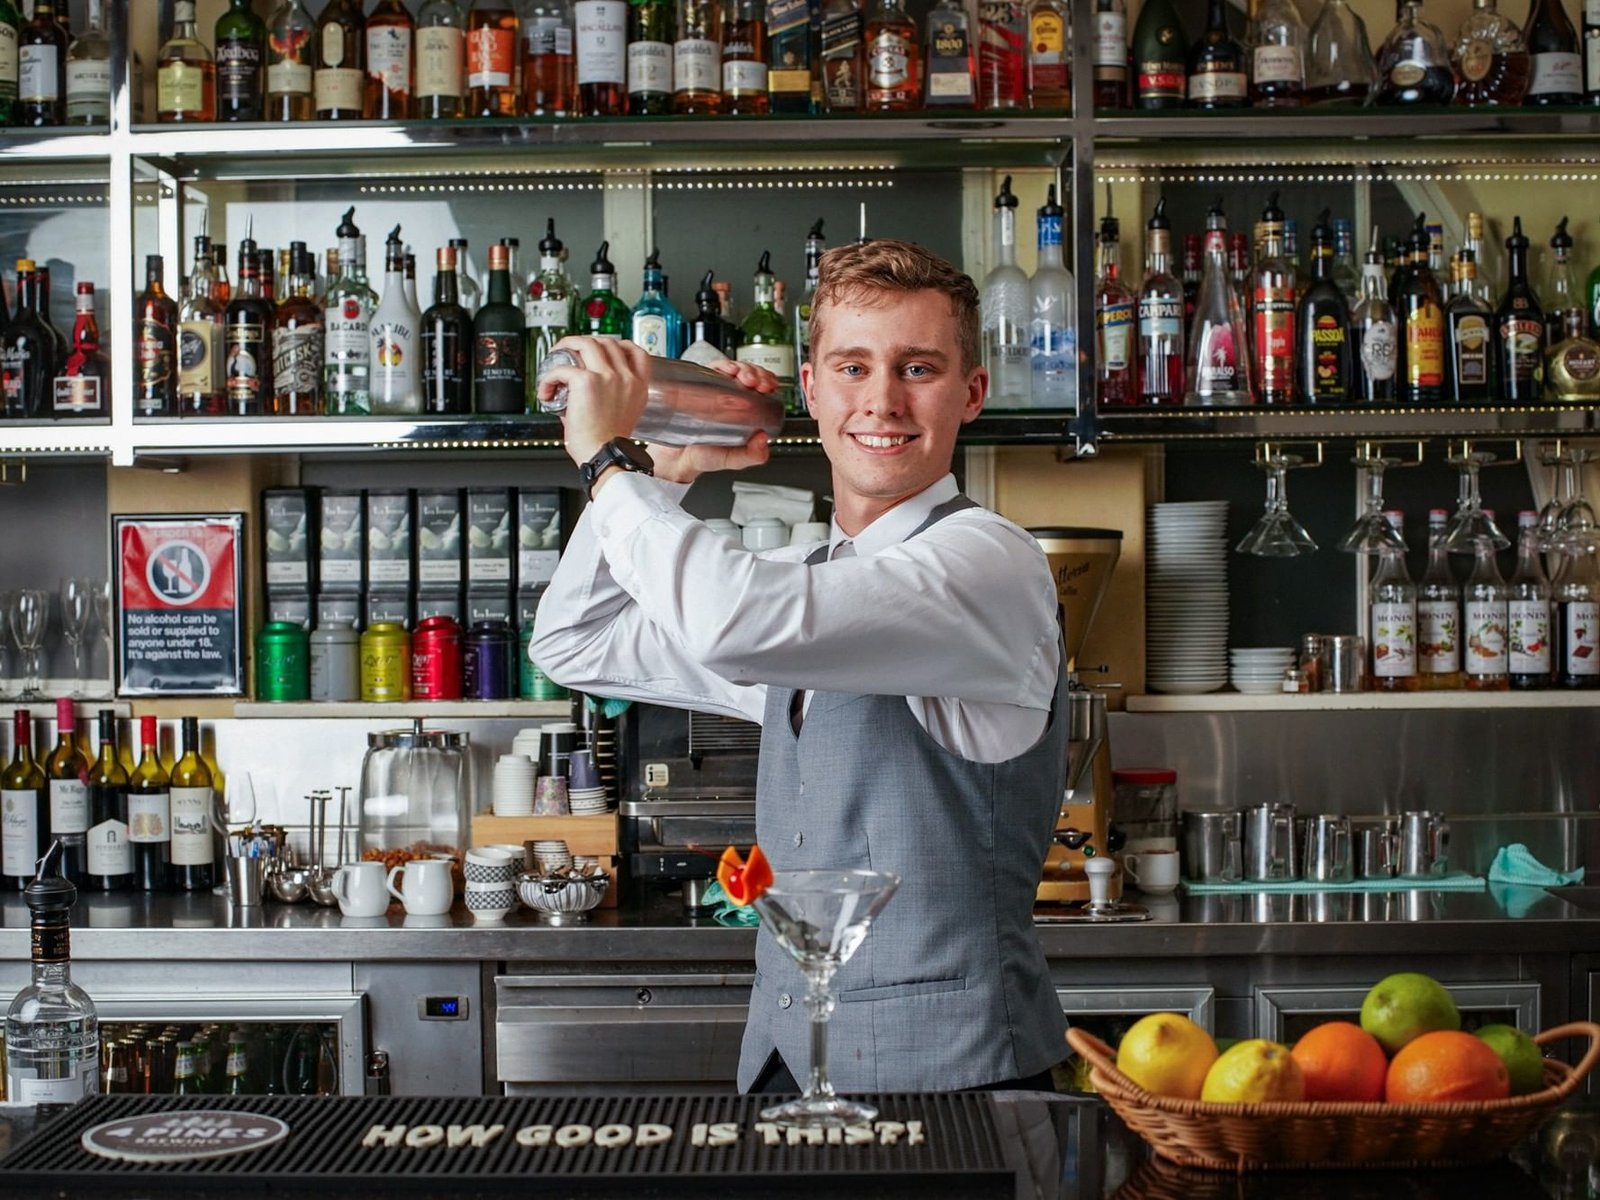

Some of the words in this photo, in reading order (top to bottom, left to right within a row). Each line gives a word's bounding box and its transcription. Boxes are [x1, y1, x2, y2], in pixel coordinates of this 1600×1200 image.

[128, 614, 142, 624] No
[144, 614, 180, 624] alcohol
[183, 616, 202, 624] can
[204, 614, 217, 624] be
[1377, 613, 1413, 622] MONIN
[1420, 612, 1453, 621] MONIN
[1510, 612, 1546, 622] MONIN
[128, 626, 150, 636] sold
[152, 628, 162, 636] or
[164, 626, 206, 639] supplied
[209, 627, 220, 636] to
[128, 640, 165, 651] anyone
[167, 638, 196, 648] under
[198, 638, 213, 648] 18.
[128, 650, 143, 660] It's
[145, 650, 182, 662] against
[184, 650, 199, 660] the
[201, 650, 222, 660] law.
[143, 1127, 268, 1139] PINES
[362, 1124, 504, 1148] HOW
[516, 1124, 672, 1148] GOOD
[692, 1123, 739, 1147] IS
